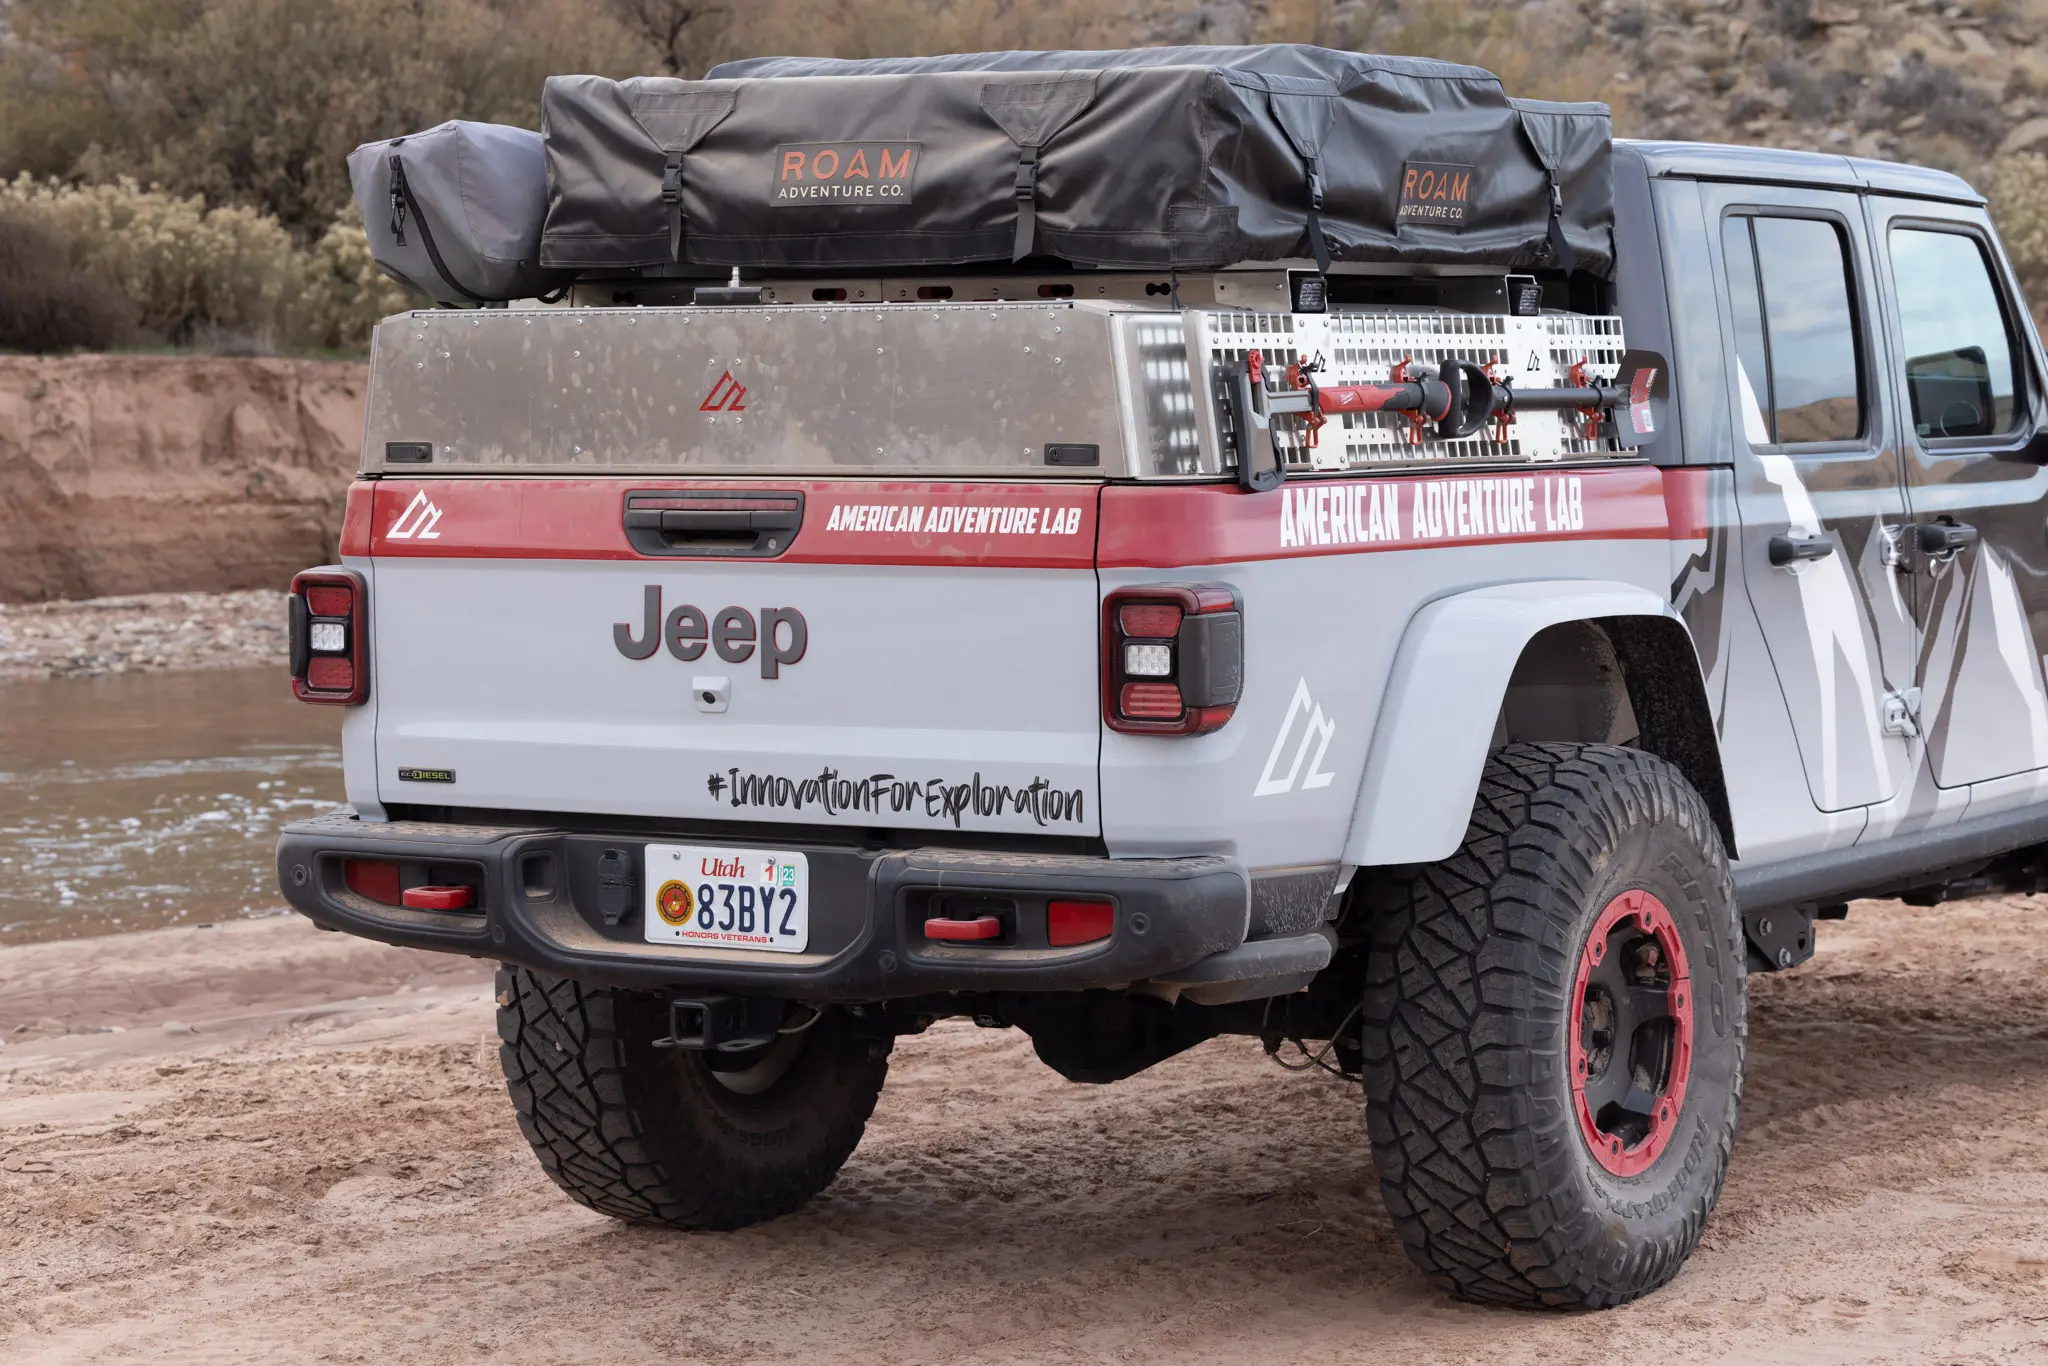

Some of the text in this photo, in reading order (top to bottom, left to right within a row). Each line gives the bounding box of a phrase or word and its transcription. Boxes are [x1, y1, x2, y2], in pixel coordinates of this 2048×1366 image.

[781, 148, 912, 182] ROAM
[778, 184, 904, 199] ADVENTURE CO.
[1403, 169, 1471, 202] ROAM
[1399, 204, 1463, 219] ADVENTURE CO.
[826, 505, 1082, 534] AMERICAN ADVENTURE LAB
[1280, 477, 1584, 548] AMERICAN ADVENTURE LAB
[613, 584, 808, 680] Jeep
[707, 766, 1083, 829] #InnovationForExploration
[700, 856, 746, 879] Utah
[764, 864, 774, 881] 1
[783, 867, 795, 881] 23
[697, 883, 798, 936] 83BY2
[681, 930, 768, 943] HONORS VETERANS
